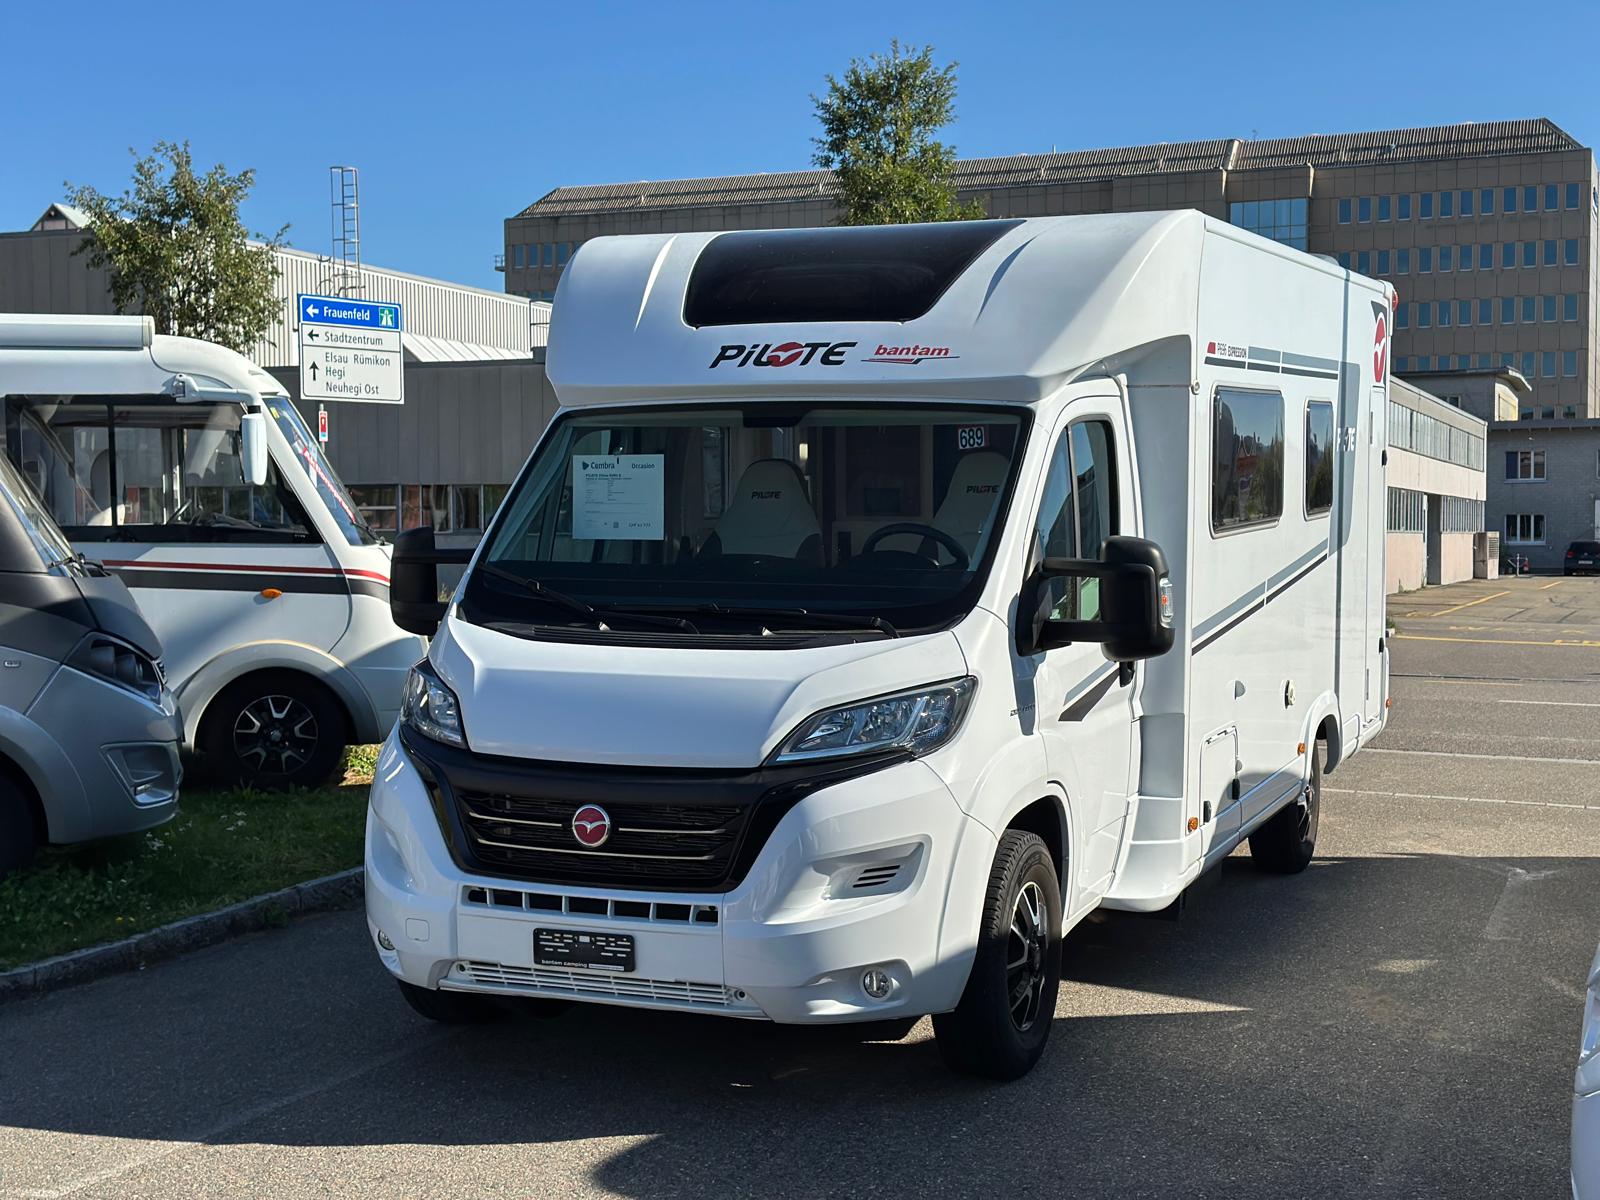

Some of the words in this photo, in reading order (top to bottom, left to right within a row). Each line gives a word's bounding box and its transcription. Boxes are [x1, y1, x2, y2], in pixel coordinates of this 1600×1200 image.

[324, 306, 370, 321] Frauenfeld
[324, 331, 383, 346] Stadtzentrum
[874, 344, 951, 356] bantam
[325, 352, 348, 363] Elsau
[353, 353, 390, 367] Rümikon
[325, 367, 346, 380] Hegi
[325, 382, 362, 396] Neuhegi
[364, 383, 379, 395] Ost
[960, 427, 984, 448] 689
[590, 461, 615, 470] Cembra
